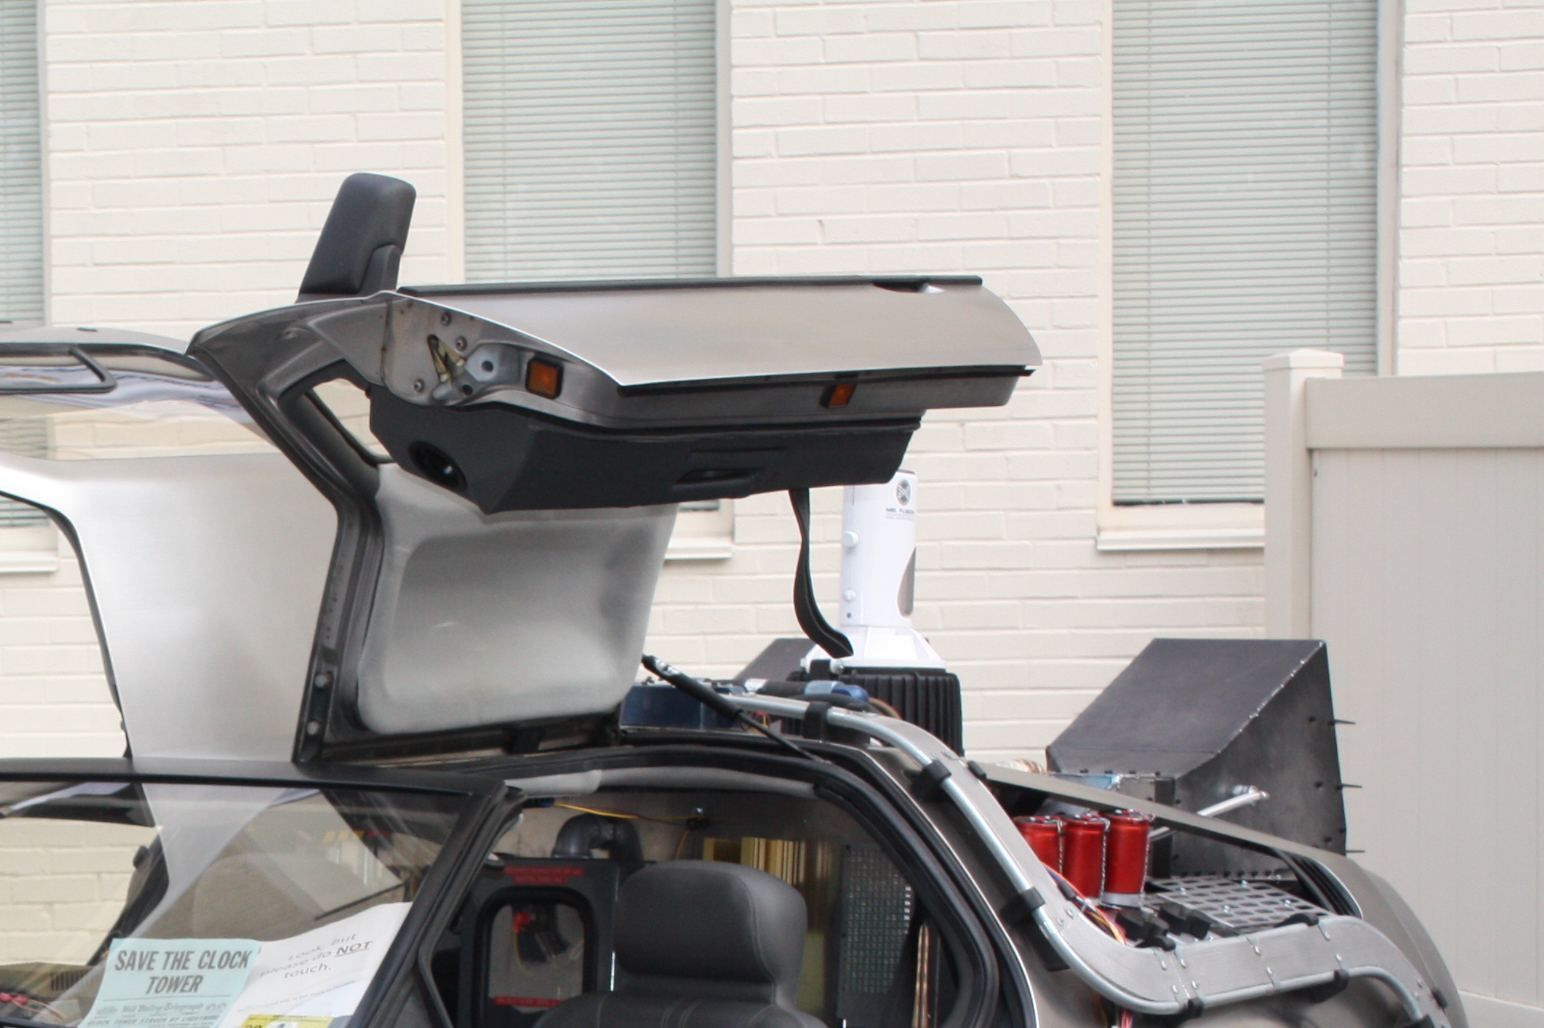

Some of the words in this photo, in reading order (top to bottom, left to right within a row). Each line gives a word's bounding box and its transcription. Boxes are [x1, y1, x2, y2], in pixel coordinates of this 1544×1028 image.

[331, 934, 357, 945] but
[114, 950, 158, 971] SAVE
[162, 951, 194, 970] THE
[198, 950, 252, 970] CLOCK
[313, 950, 331, 961] do
[336, 941, 373, 957] NOT
[284, 962, 331, 979] touch.
[146, 975, 204, 995] TOWER
